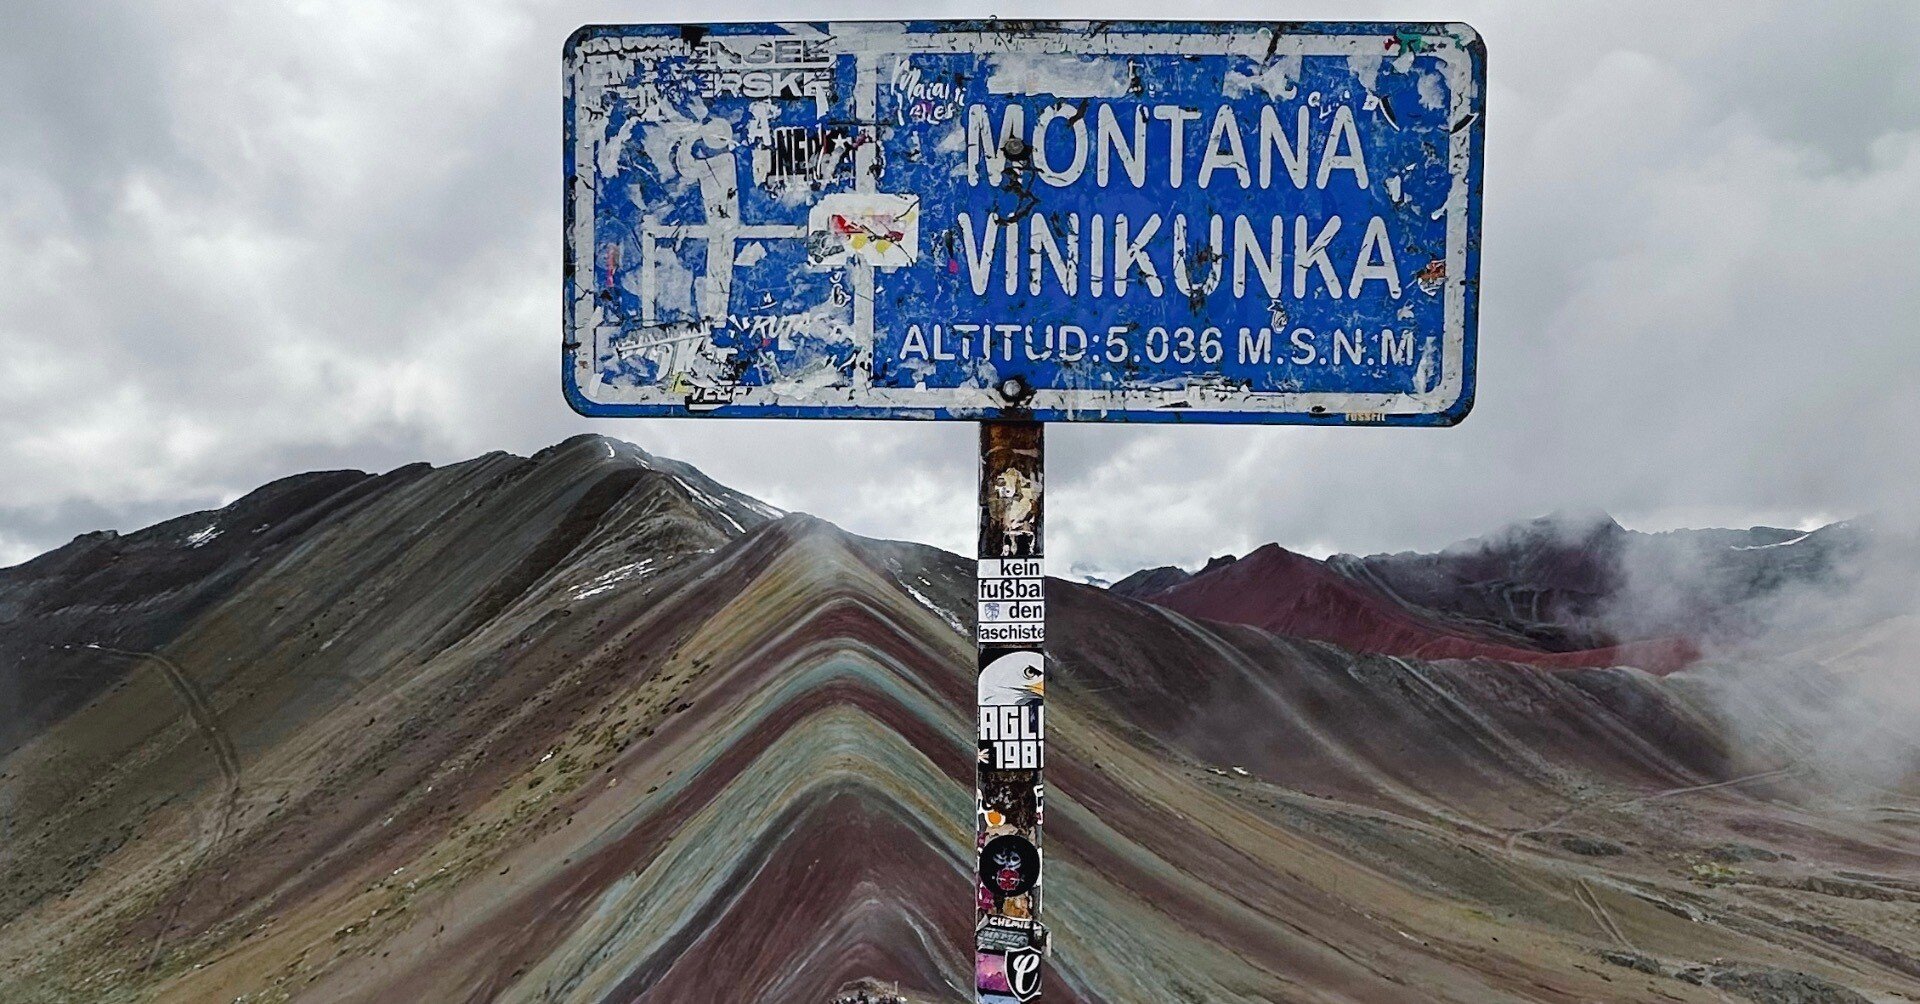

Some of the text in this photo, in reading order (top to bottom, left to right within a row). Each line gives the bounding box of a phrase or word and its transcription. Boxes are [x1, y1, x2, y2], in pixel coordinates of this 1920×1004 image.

[968, 103, 1369, 190] MONTANA
[957, 212, 1402, 300] VINIKUNKA
[1000, 558, 1039, 576] kein
[1008, 601, 1042, 618] den
[993, 741, 1044, 769] 1981
